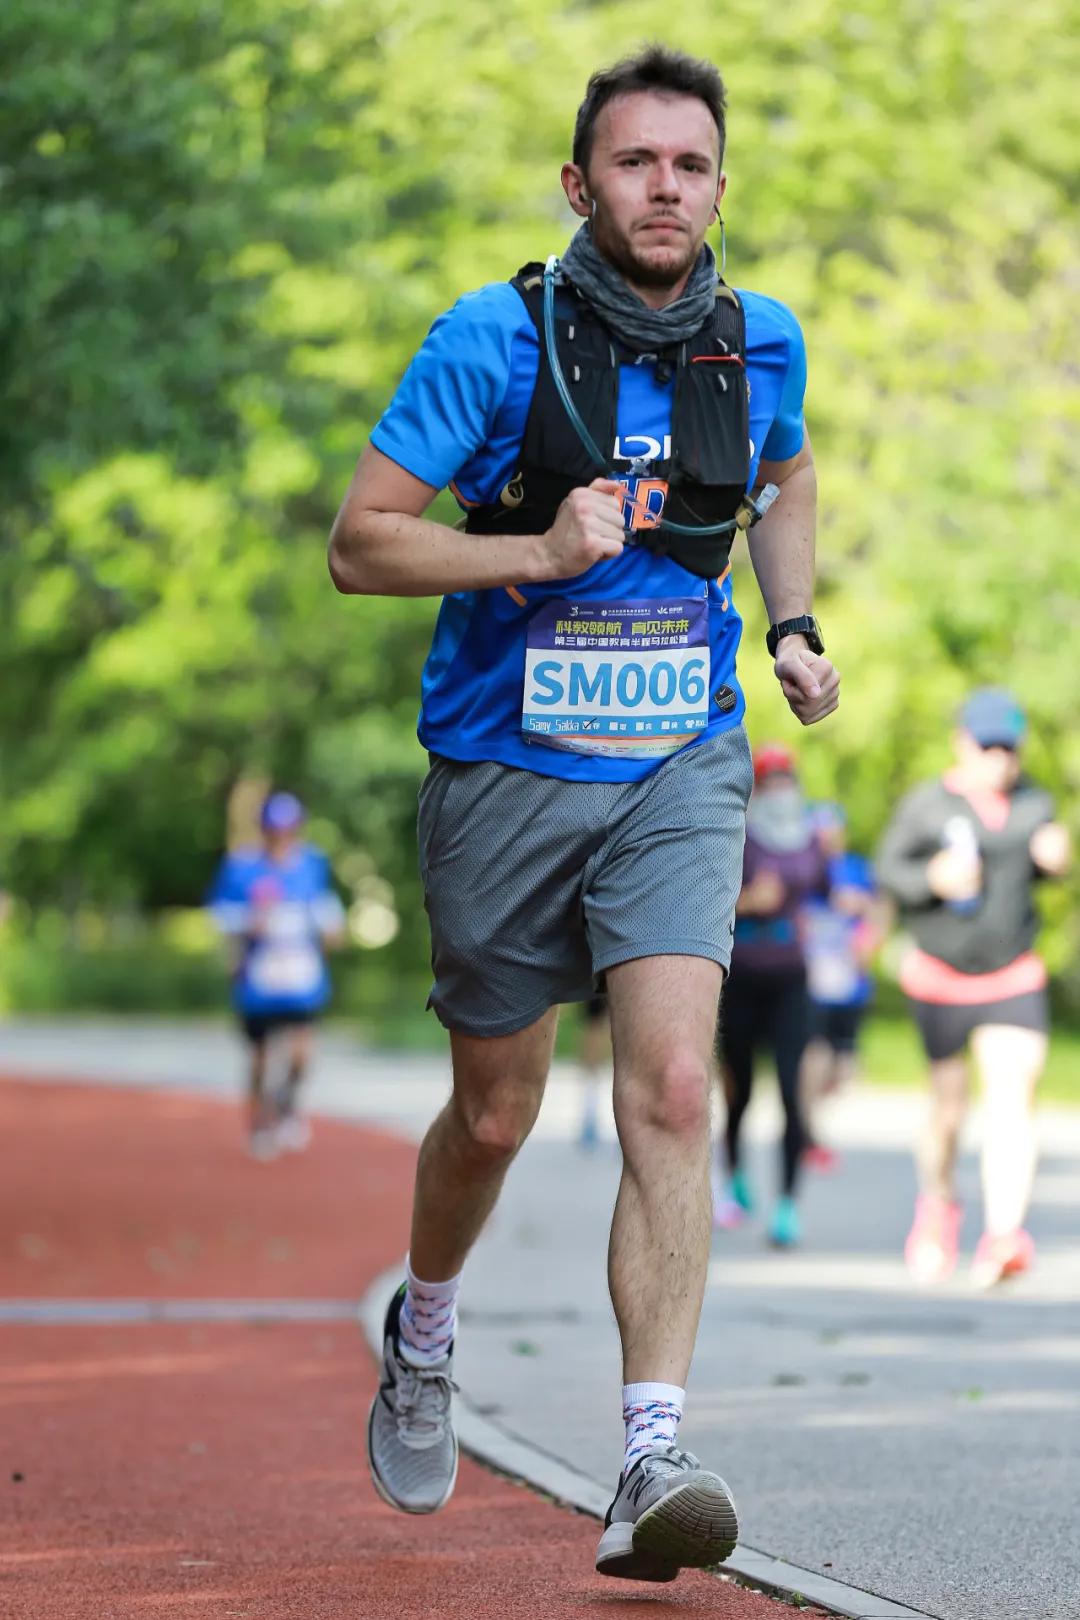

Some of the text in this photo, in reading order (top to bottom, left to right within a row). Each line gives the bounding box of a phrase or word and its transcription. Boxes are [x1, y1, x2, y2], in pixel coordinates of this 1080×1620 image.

[530, 658, 706, 708] SM006
[529, 717, 551, 733] Samy
[555, 719, 580, 732] Sakka
